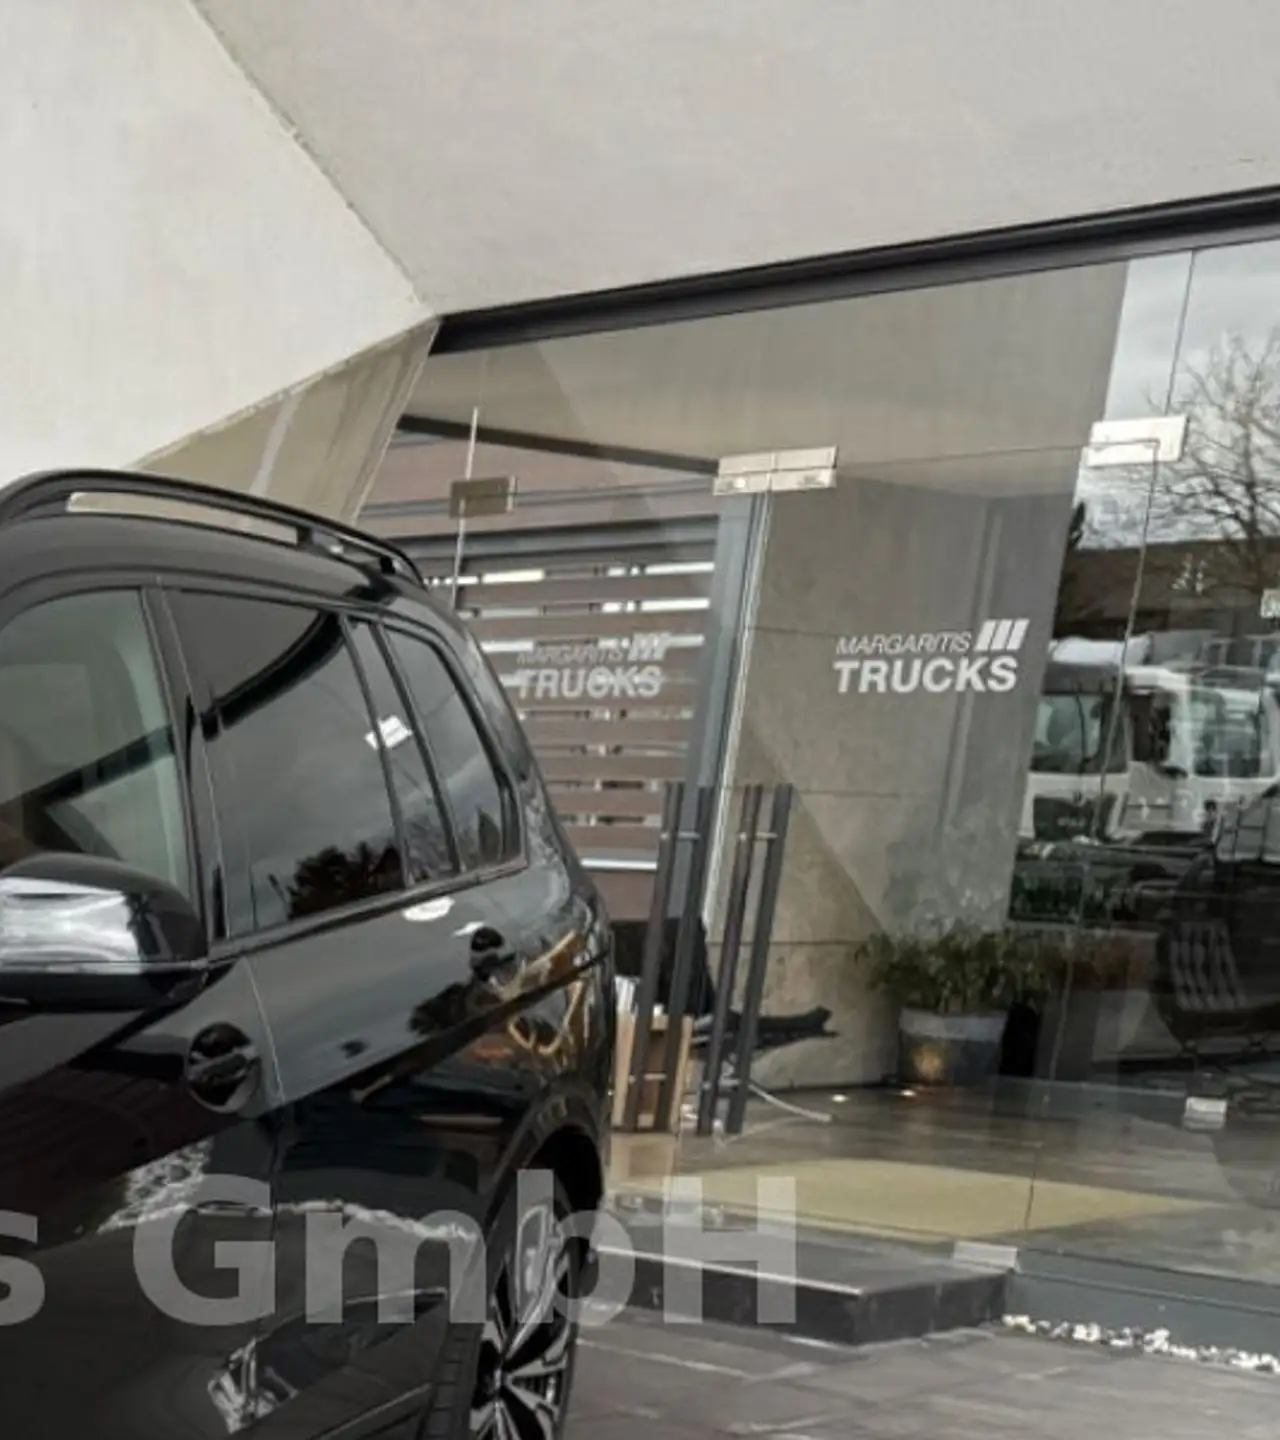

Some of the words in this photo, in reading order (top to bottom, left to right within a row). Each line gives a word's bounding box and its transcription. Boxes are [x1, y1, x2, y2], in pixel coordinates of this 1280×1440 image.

[836, 631, 973, 654] MARGARITIS
[516, 665, 663, 698] TRUCKS
[834, 655, 1019, 693] TRUCKS
